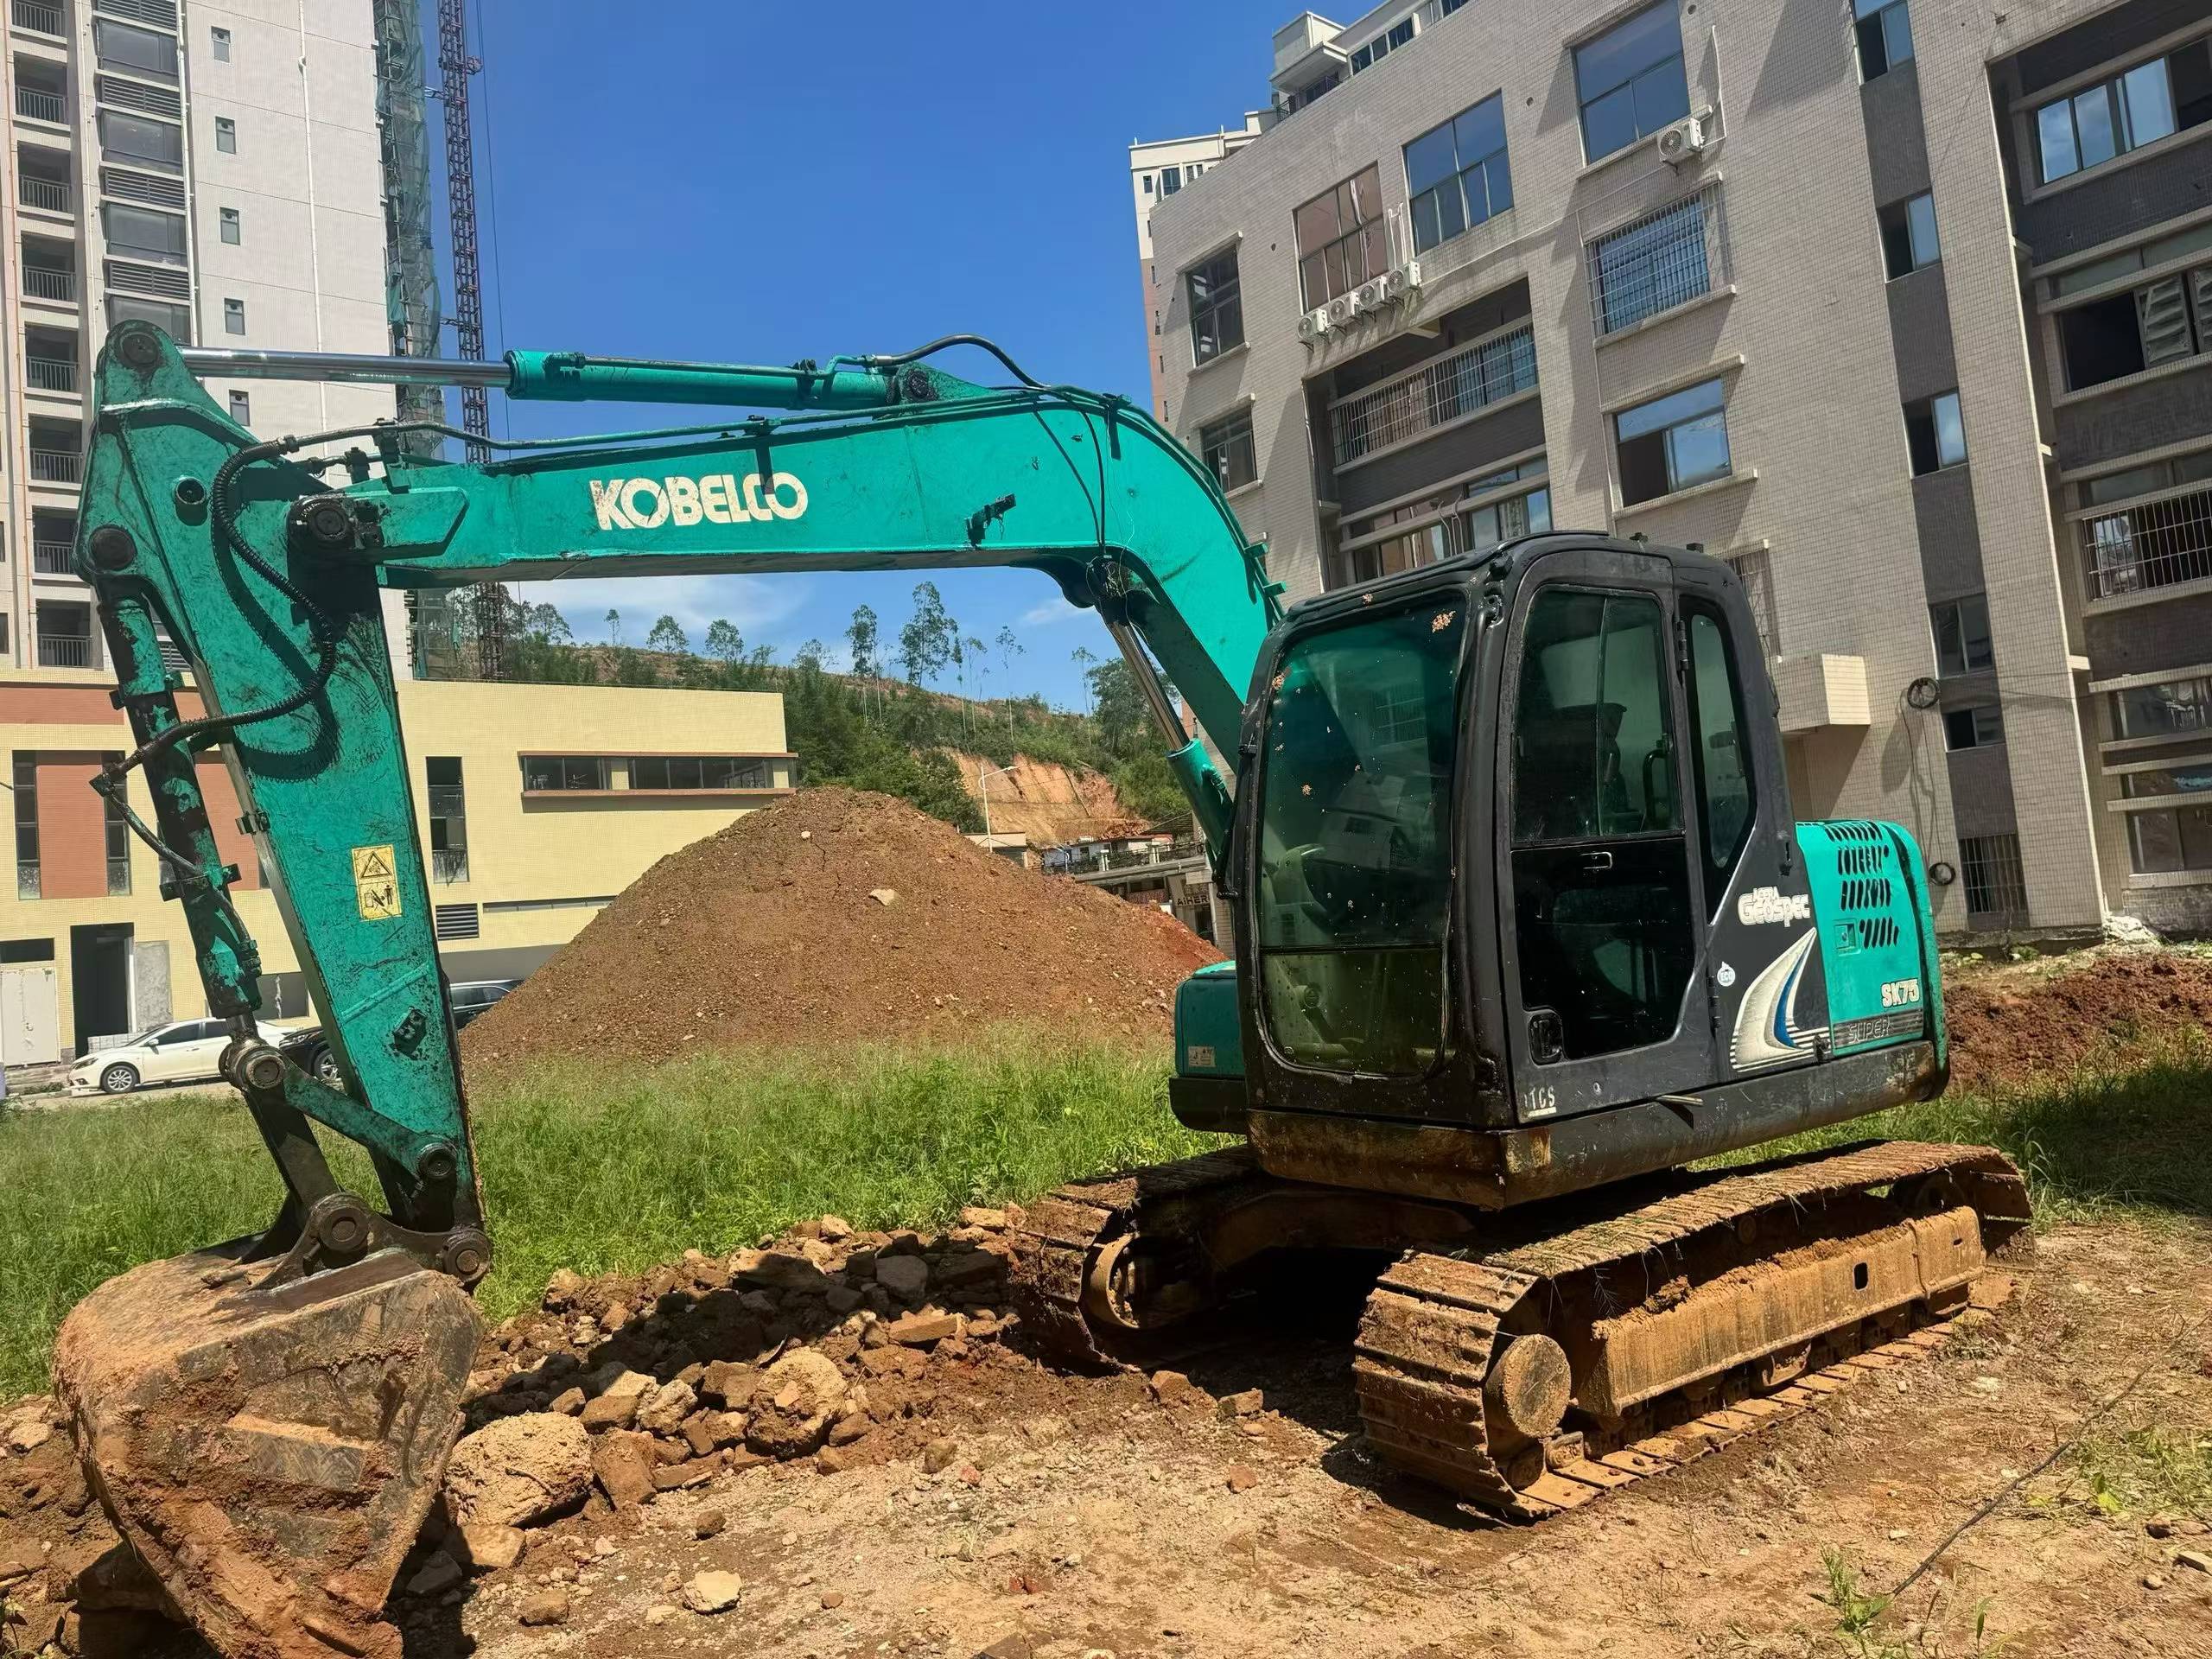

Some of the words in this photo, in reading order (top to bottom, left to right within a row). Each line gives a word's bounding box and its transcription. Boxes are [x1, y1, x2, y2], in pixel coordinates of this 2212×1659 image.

[589, 472, 809, 531] KOBELCO
[1881, 978, 1920, 1008] SK75
[1849, 1016, 1891, 1044] SUPER
